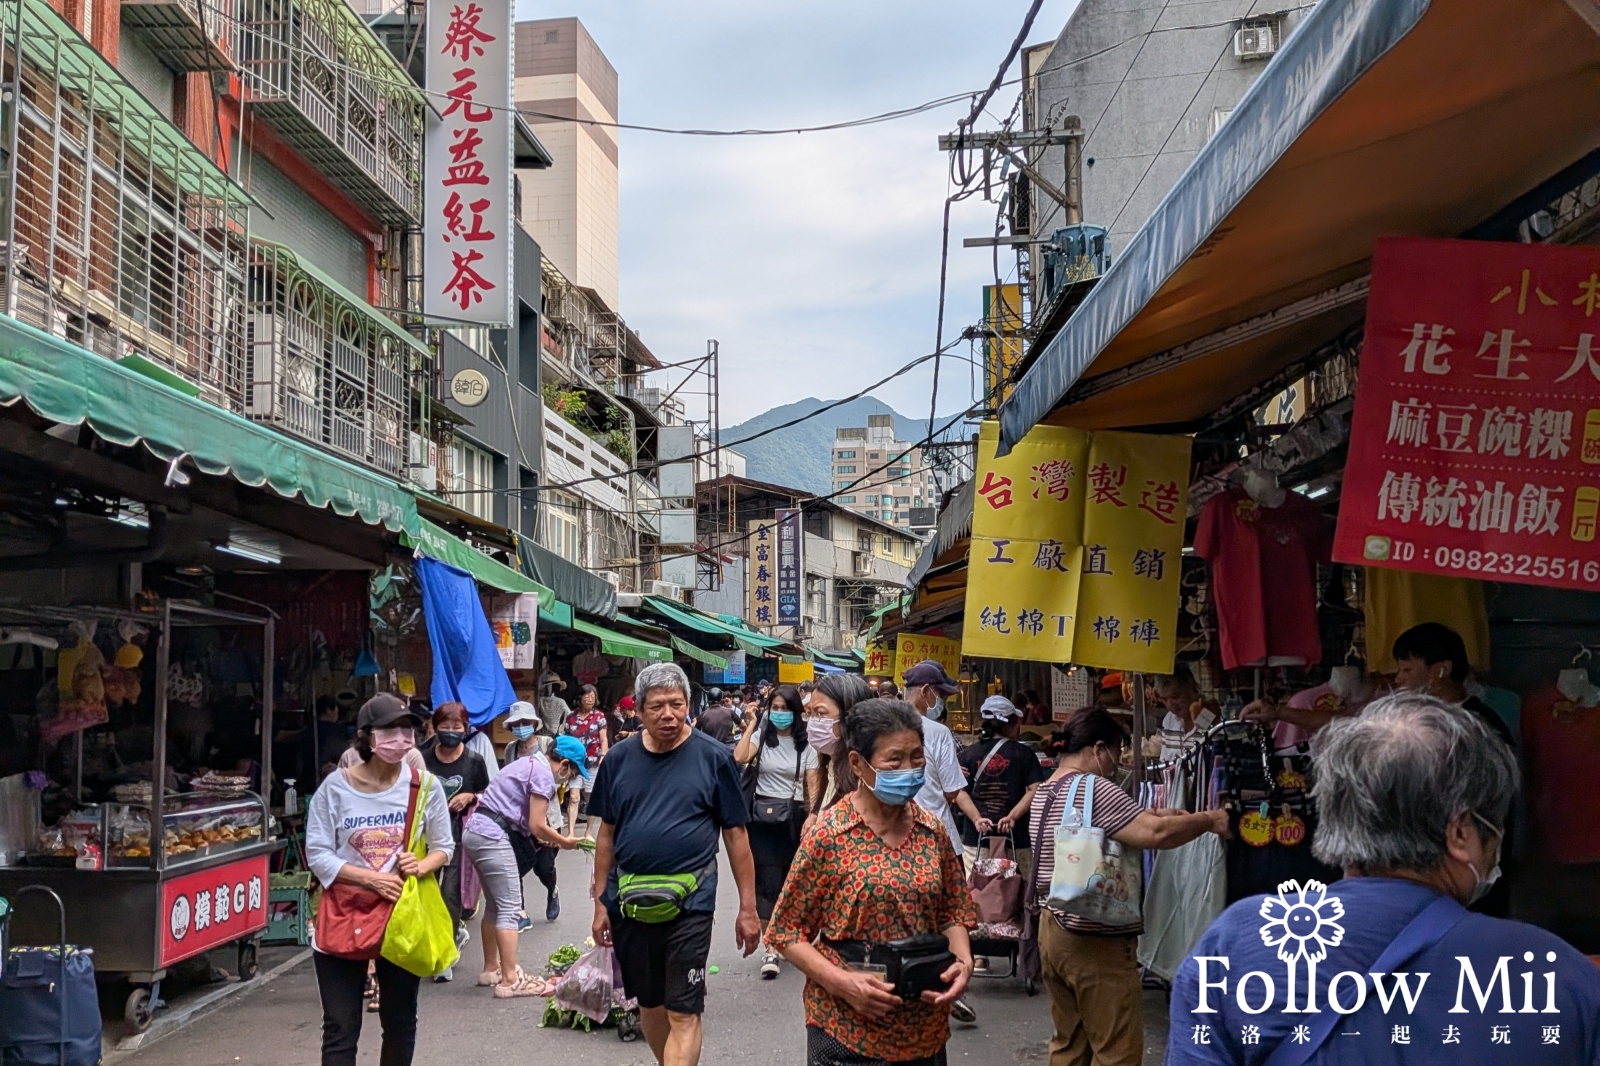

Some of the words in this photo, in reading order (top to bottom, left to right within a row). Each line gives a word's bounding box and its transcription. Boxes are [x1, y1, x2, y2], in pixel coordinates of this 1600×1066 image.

[441, 3, 496, 310] 蔡元益紅茶
[1399, 323, 1600, 383] 花生大
[1386, 398, 1574, 460] 麻豆碗粿
[977, 459, 1181, 525] 台灣製造
[1377, 470, 1565, 536] 傳統油飯
[755, 523, 772, 623] 金富春銀樓
[987, 539, 1166, 581] 工廠直銷
[780, 595, 796, 604] GIA
[979, 605, 1074, 637] 純棉T
[1092, 615, 1161, 648] 棉褲
[869, 651, 889, 671] 炸
[1280, 825, 1301, 841] 100
[194, 875, 261, 932] 模範G肉
